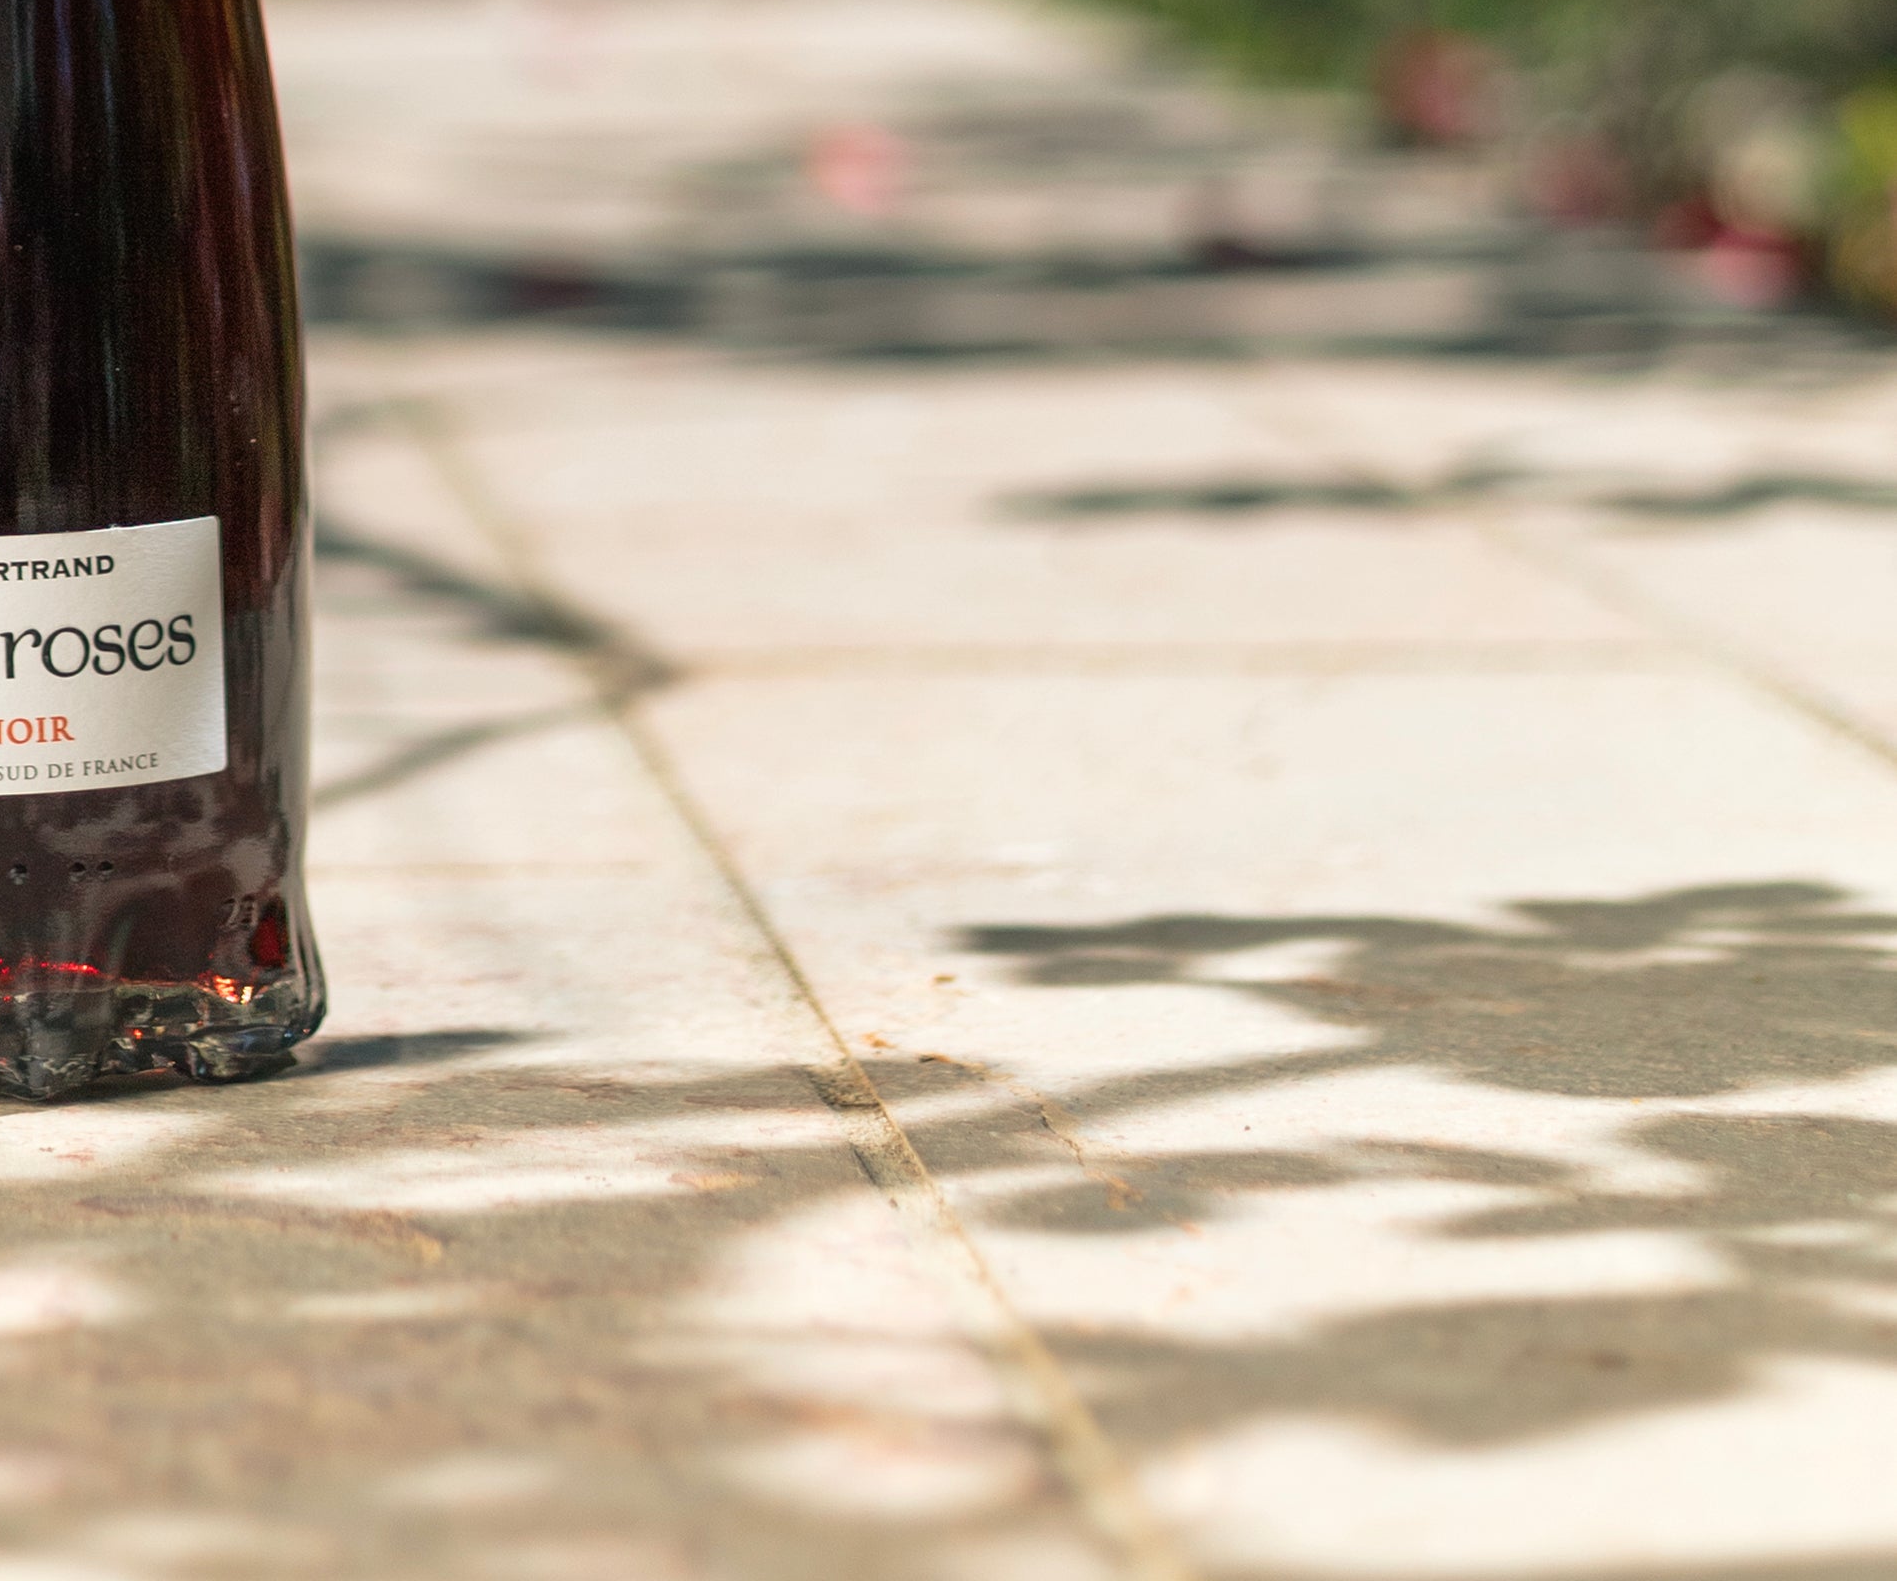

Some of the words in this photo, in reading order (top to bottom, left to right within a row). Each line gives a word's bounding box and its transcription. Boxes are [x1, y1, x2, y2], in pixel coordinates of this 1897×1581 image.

[0, 613, 196, 681] roses
[47, 761, 75, 779] DE
[83, 751, 160, 777] FRANCE
